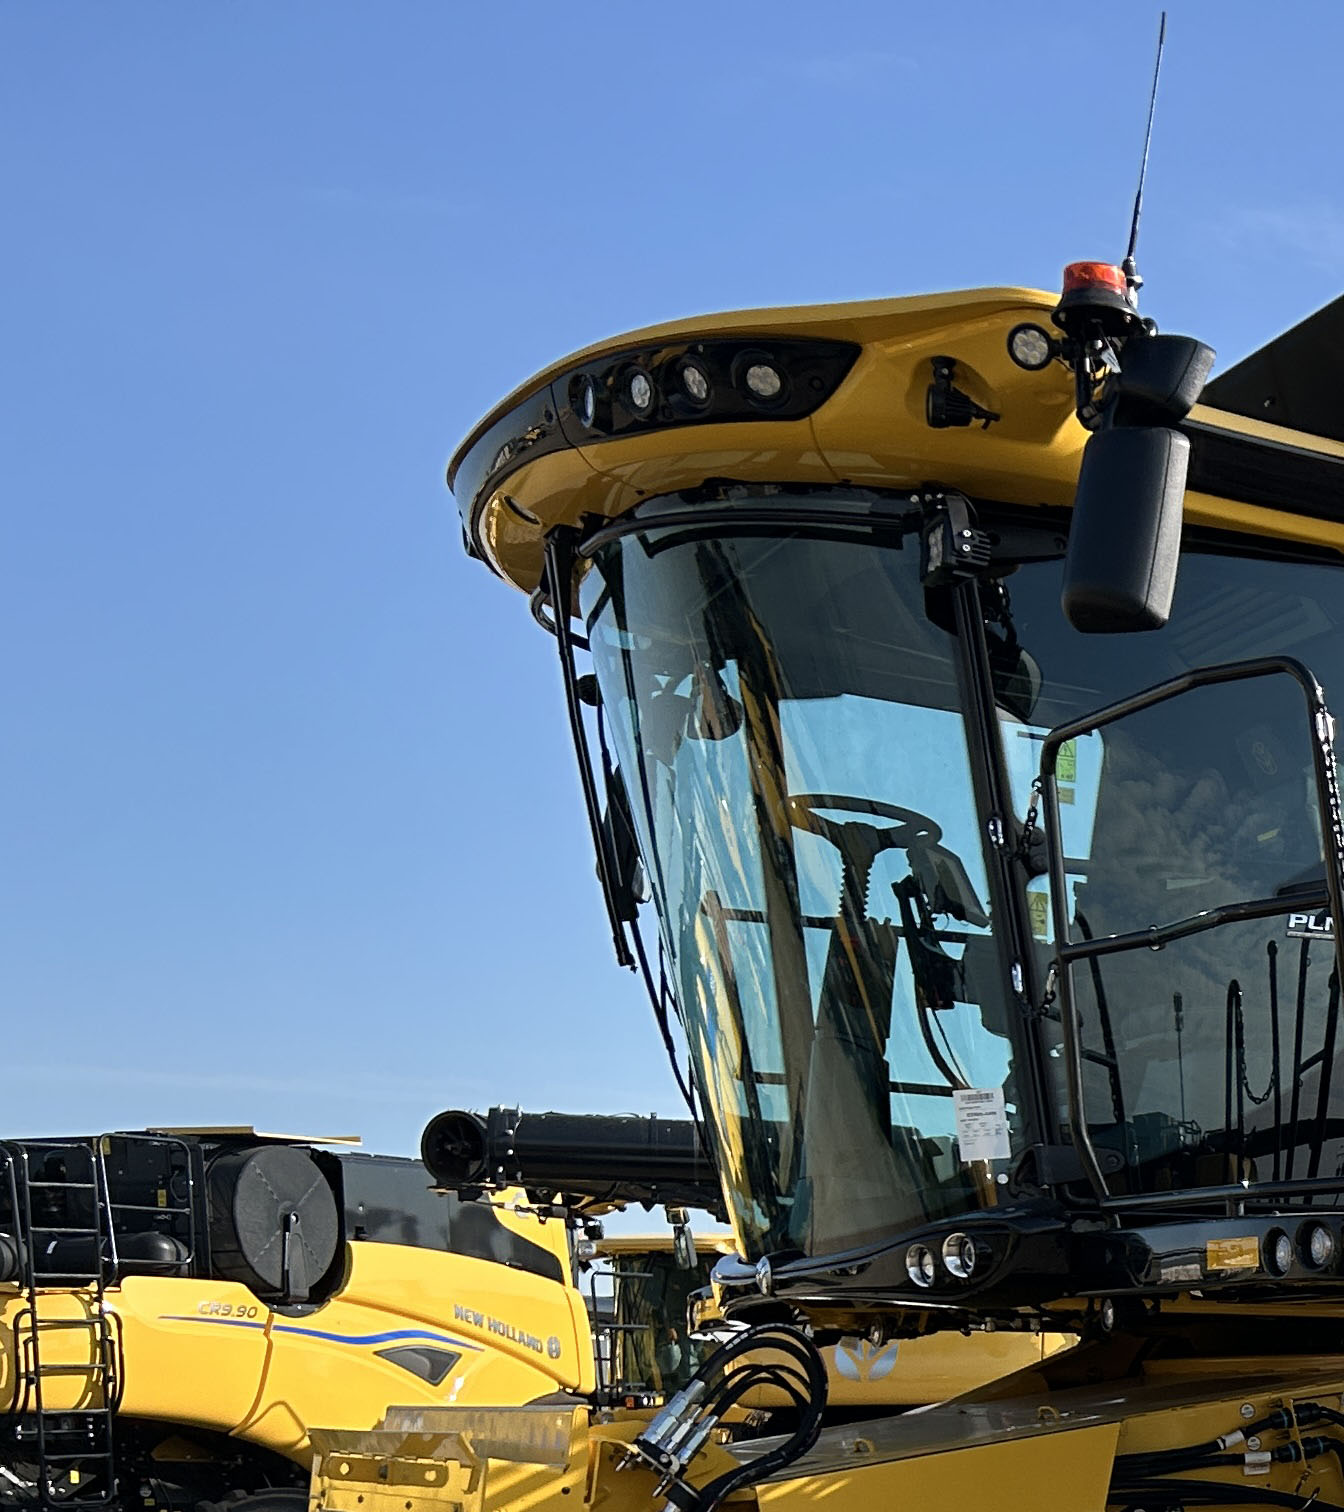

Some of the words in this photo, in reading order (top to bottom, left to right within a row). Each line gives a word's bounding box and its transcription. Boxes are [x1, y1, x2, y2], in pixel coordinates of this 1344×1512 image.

[198, 1302, 259, 1319] CR9.90
[453, 1303, 485, 1329] NEW
[486, 1315, 544, 1354] HOLLAND
